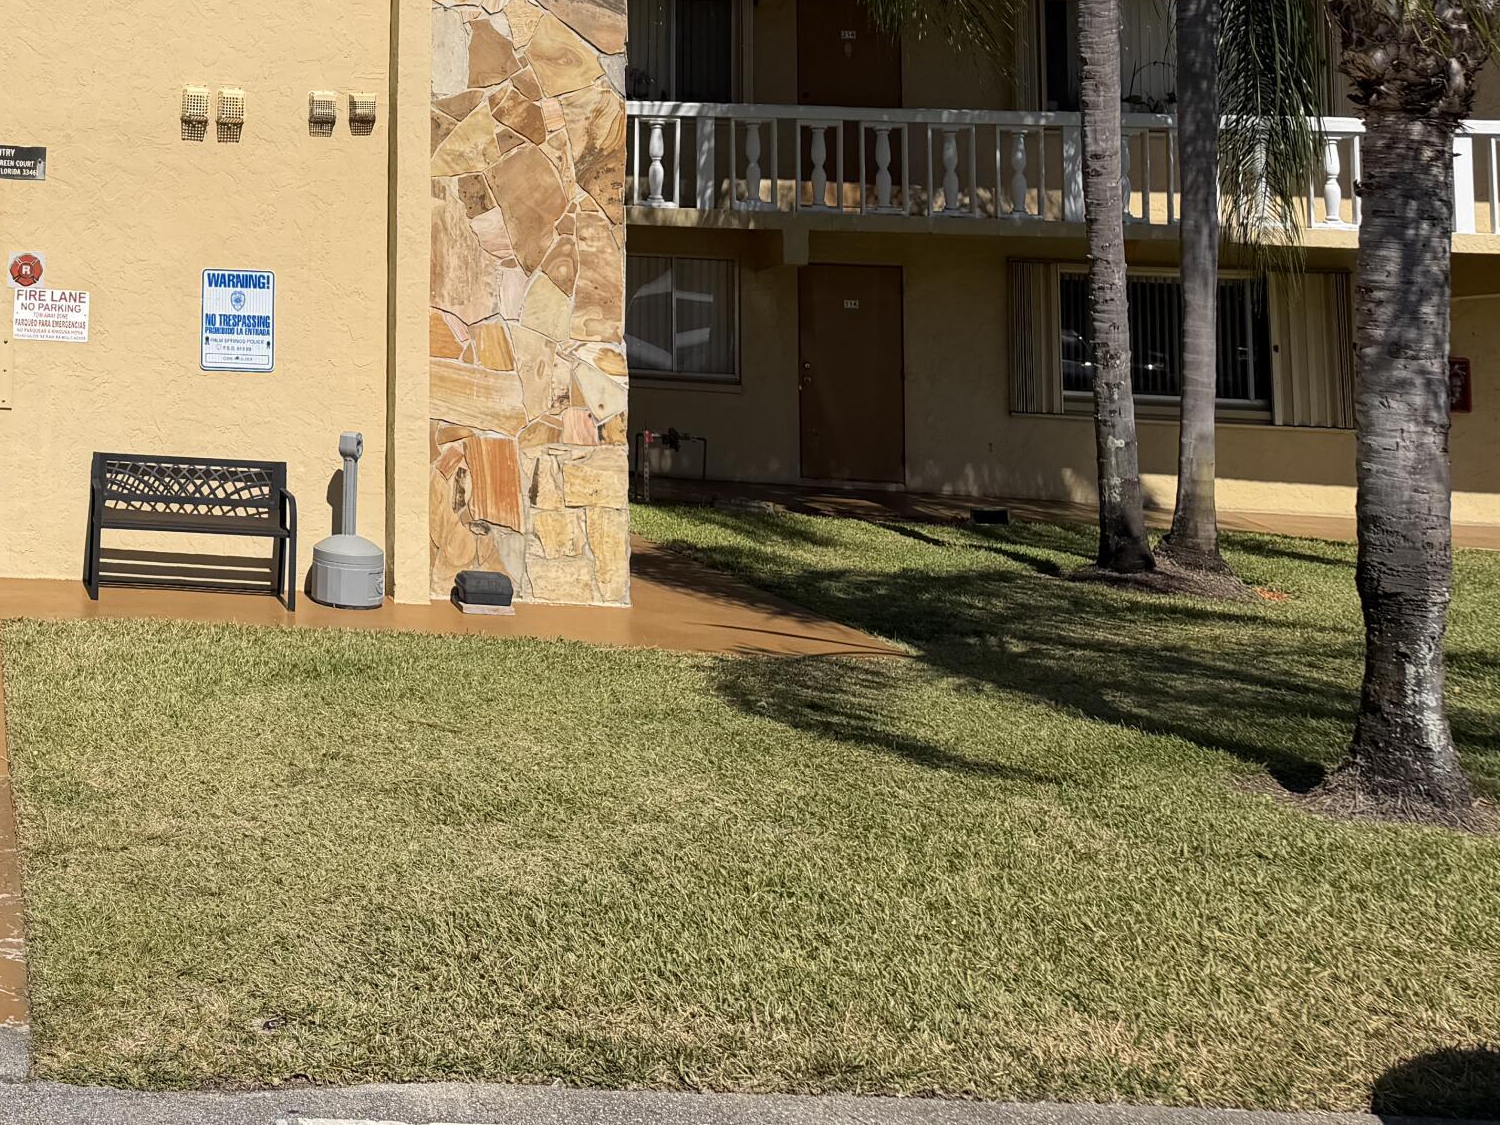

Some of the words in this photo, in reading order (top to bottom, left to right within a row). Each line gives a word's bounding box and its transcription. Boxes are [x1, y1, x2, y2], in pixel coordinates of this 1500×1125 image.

[22, 265, 30, 274] R
[207, 273, 270, 289] WARNING!
[16, 290, 46, 302] FIRE
[51, 291, 86, 303] LANE
[21, 302, 35, 311] NO
[38, 303, 81, 313] PARKING
[15, 318, 38, 326] PARQUEO
[52, 320, 86, 329] EMERGENCIAS
[205, 313, 216, 326] NO
[218, 314, 270, 328] TRESPASSING
